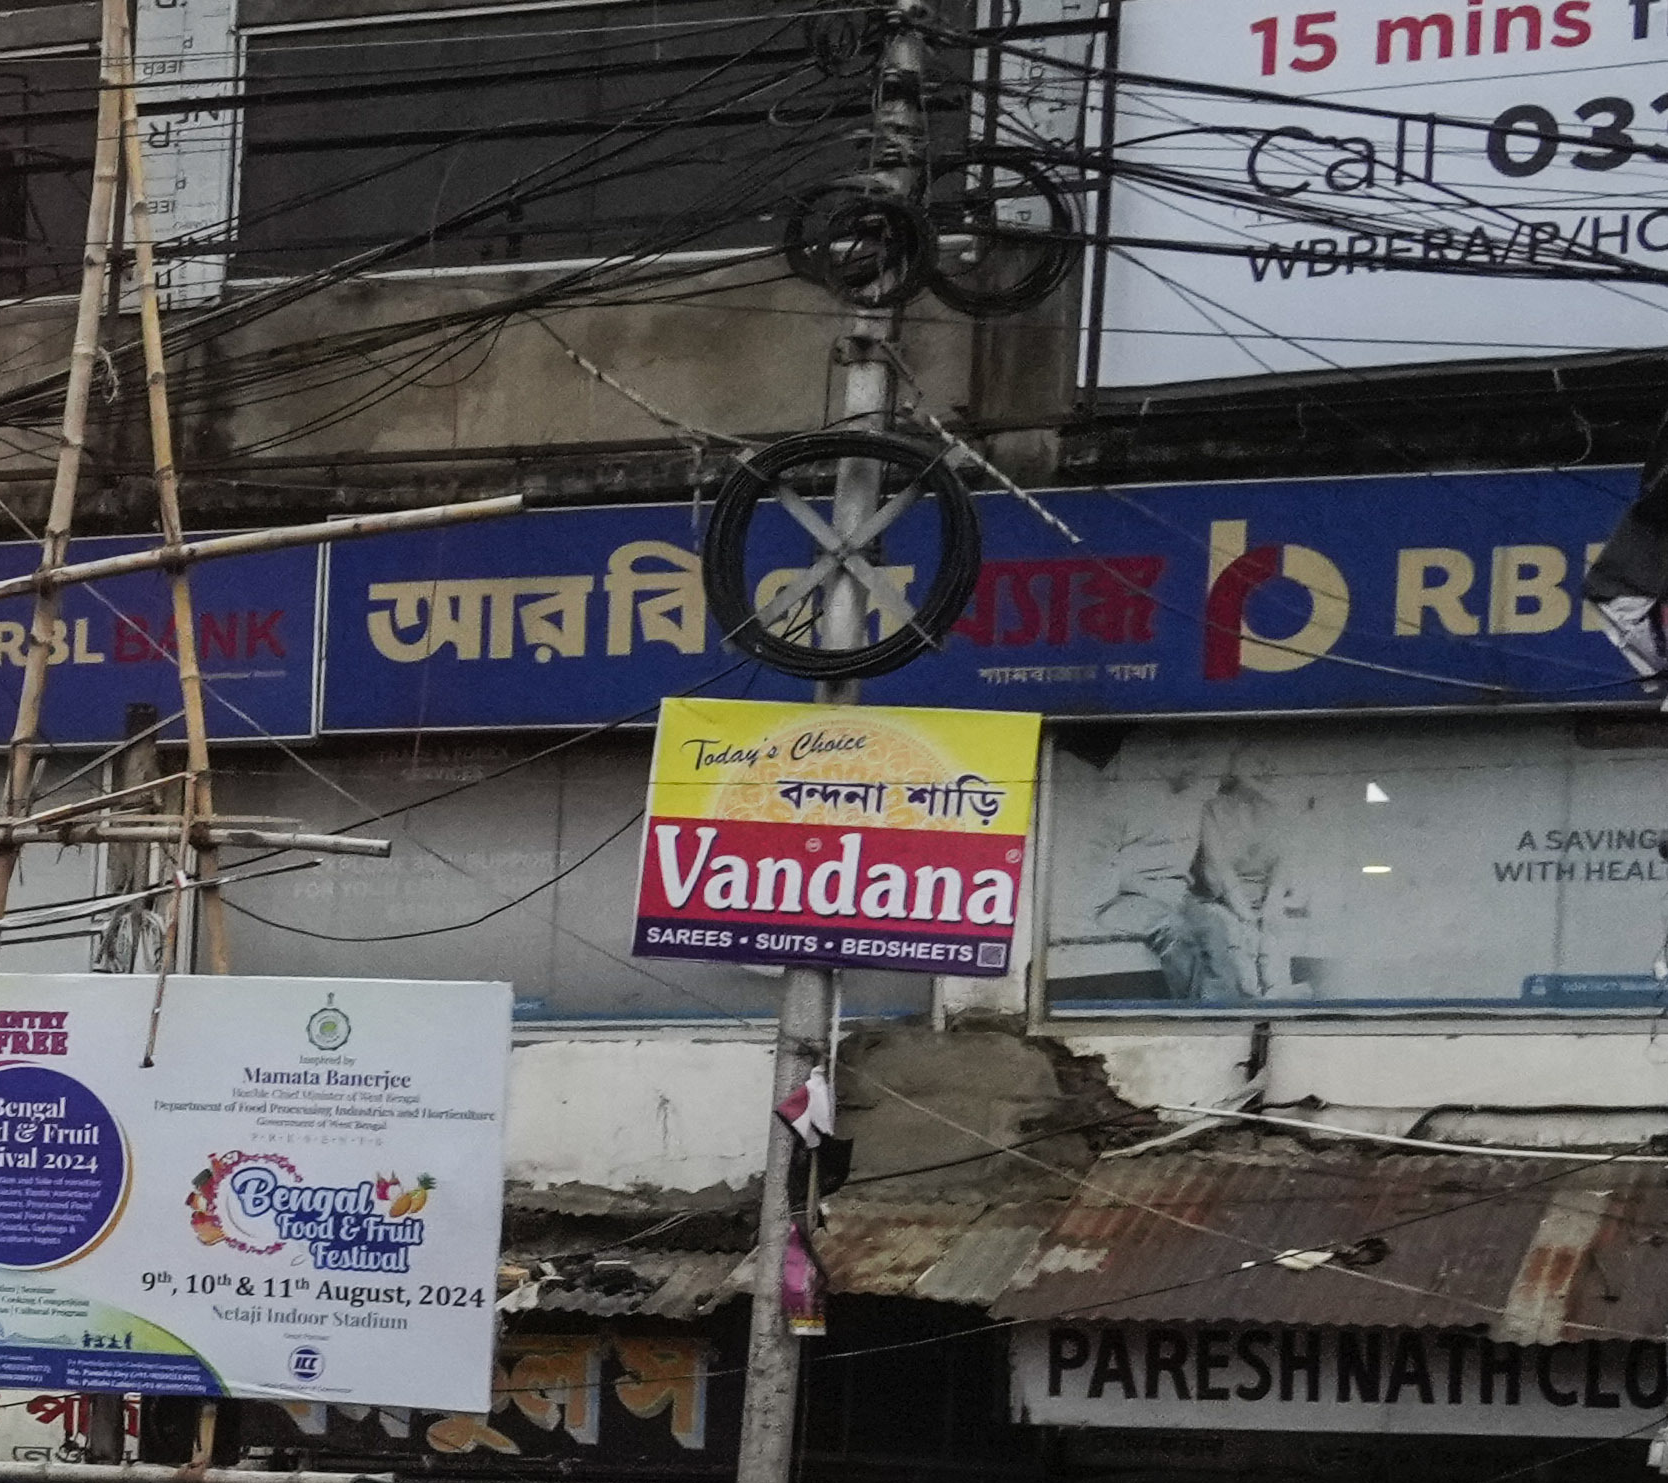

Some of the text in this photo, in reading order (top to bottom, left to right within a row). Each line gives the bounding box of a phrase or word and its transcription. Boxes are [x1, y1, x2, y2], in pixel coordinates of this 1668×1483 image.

[1250, 10, 1337, 77] 15
[1375, 0, 1592, 65] mins
[1247, 114, 1435, 197] Call
[113, 610, 285, 663] BANK
[367, 574, 594, 664] আর
[681, 731, 867, 771] Today's Choice
[777, 774, 1006, 826] বন্দনা শাড়ি
[1517, 829, 1658, 851] A SAVING
[654, 824, 1015, 927] Vandana
[1494, 862, 1575, 882] WITH
[647, 927, 974, 963] SAREES SUITS BEDSHEETS
[243, 1067, 411, 1090] Mamata Banerjee
[14, 1121, 37, 1143] &
[43, 1123, 100, 1145] Fruit
[43, 1153, 99, 1174] 2024
[231, 1167, 375, 1218] Bengal
[276, 1213, 423, 1246] Food & Fruit
[310, 1242, 410, 1273] Festival
[186, 1272, 232, 1295] 10th
[236, 1276, 255, 1296] &
[264, 1276, 310, 1298] 11th
[316, 1280, 412, 1308] August,
[419, 1285, 486, 1309] 2024
[212, 1305, 408, 1330] Netaji Indoor Stadium
[1047, 1327, 1321, 1403] PARESH
[1336, 1329, 1522, 1406] NATH
